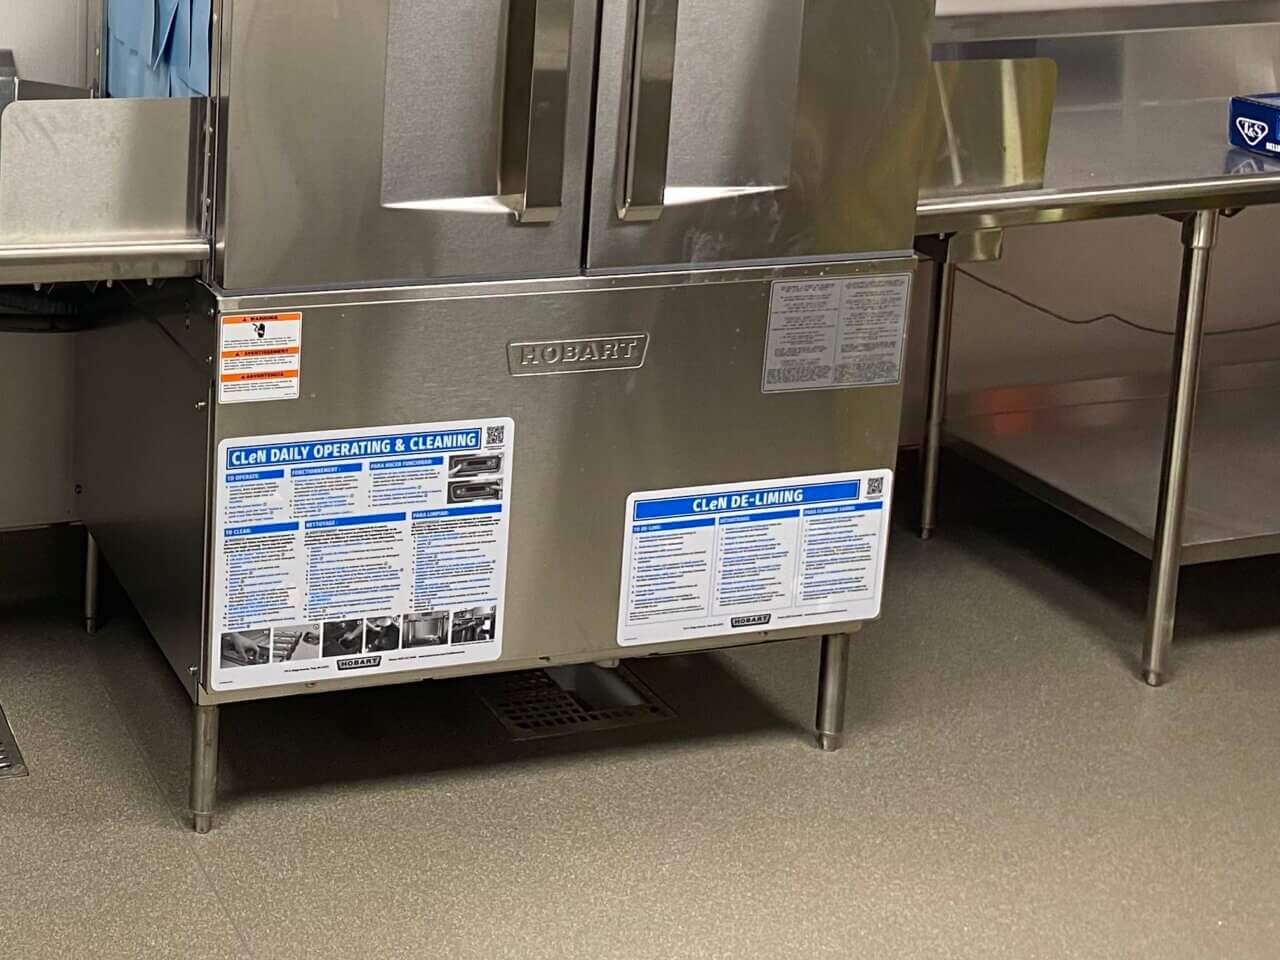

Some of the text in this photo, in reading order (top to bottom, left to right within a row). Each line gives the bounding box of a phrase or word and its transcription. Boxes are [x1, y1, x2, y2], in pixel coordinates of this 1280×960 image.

[520, 339, 637, 365] HOBART
[231, 433, 476, 465] CLeN DAILY OPERATING & CLEANING
[692, 489, 803, 513] CLeN DE-LIMING
[734, 616, 768, 625] HOBART
[341, 659, 378, 667] HOBART
